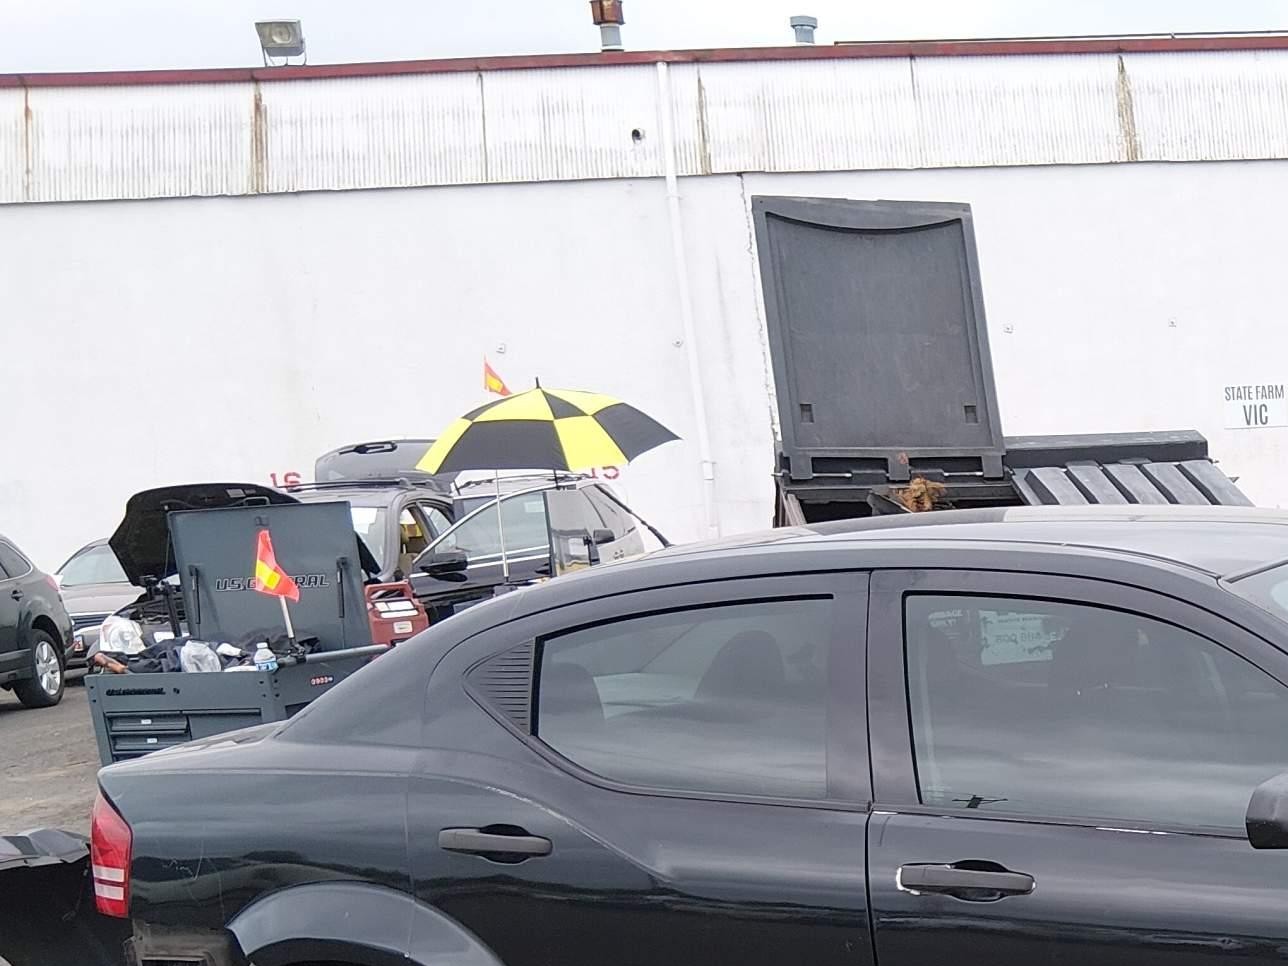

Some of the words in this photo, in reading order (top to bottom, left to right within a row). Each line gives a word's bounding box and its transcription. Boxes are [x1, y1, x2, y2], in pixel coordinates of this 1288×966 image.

[1224, 386, 1253, 401] STATE
[1255, 384, 1285, 400] FARM
[1243, 403, 1268, 425] VIC
